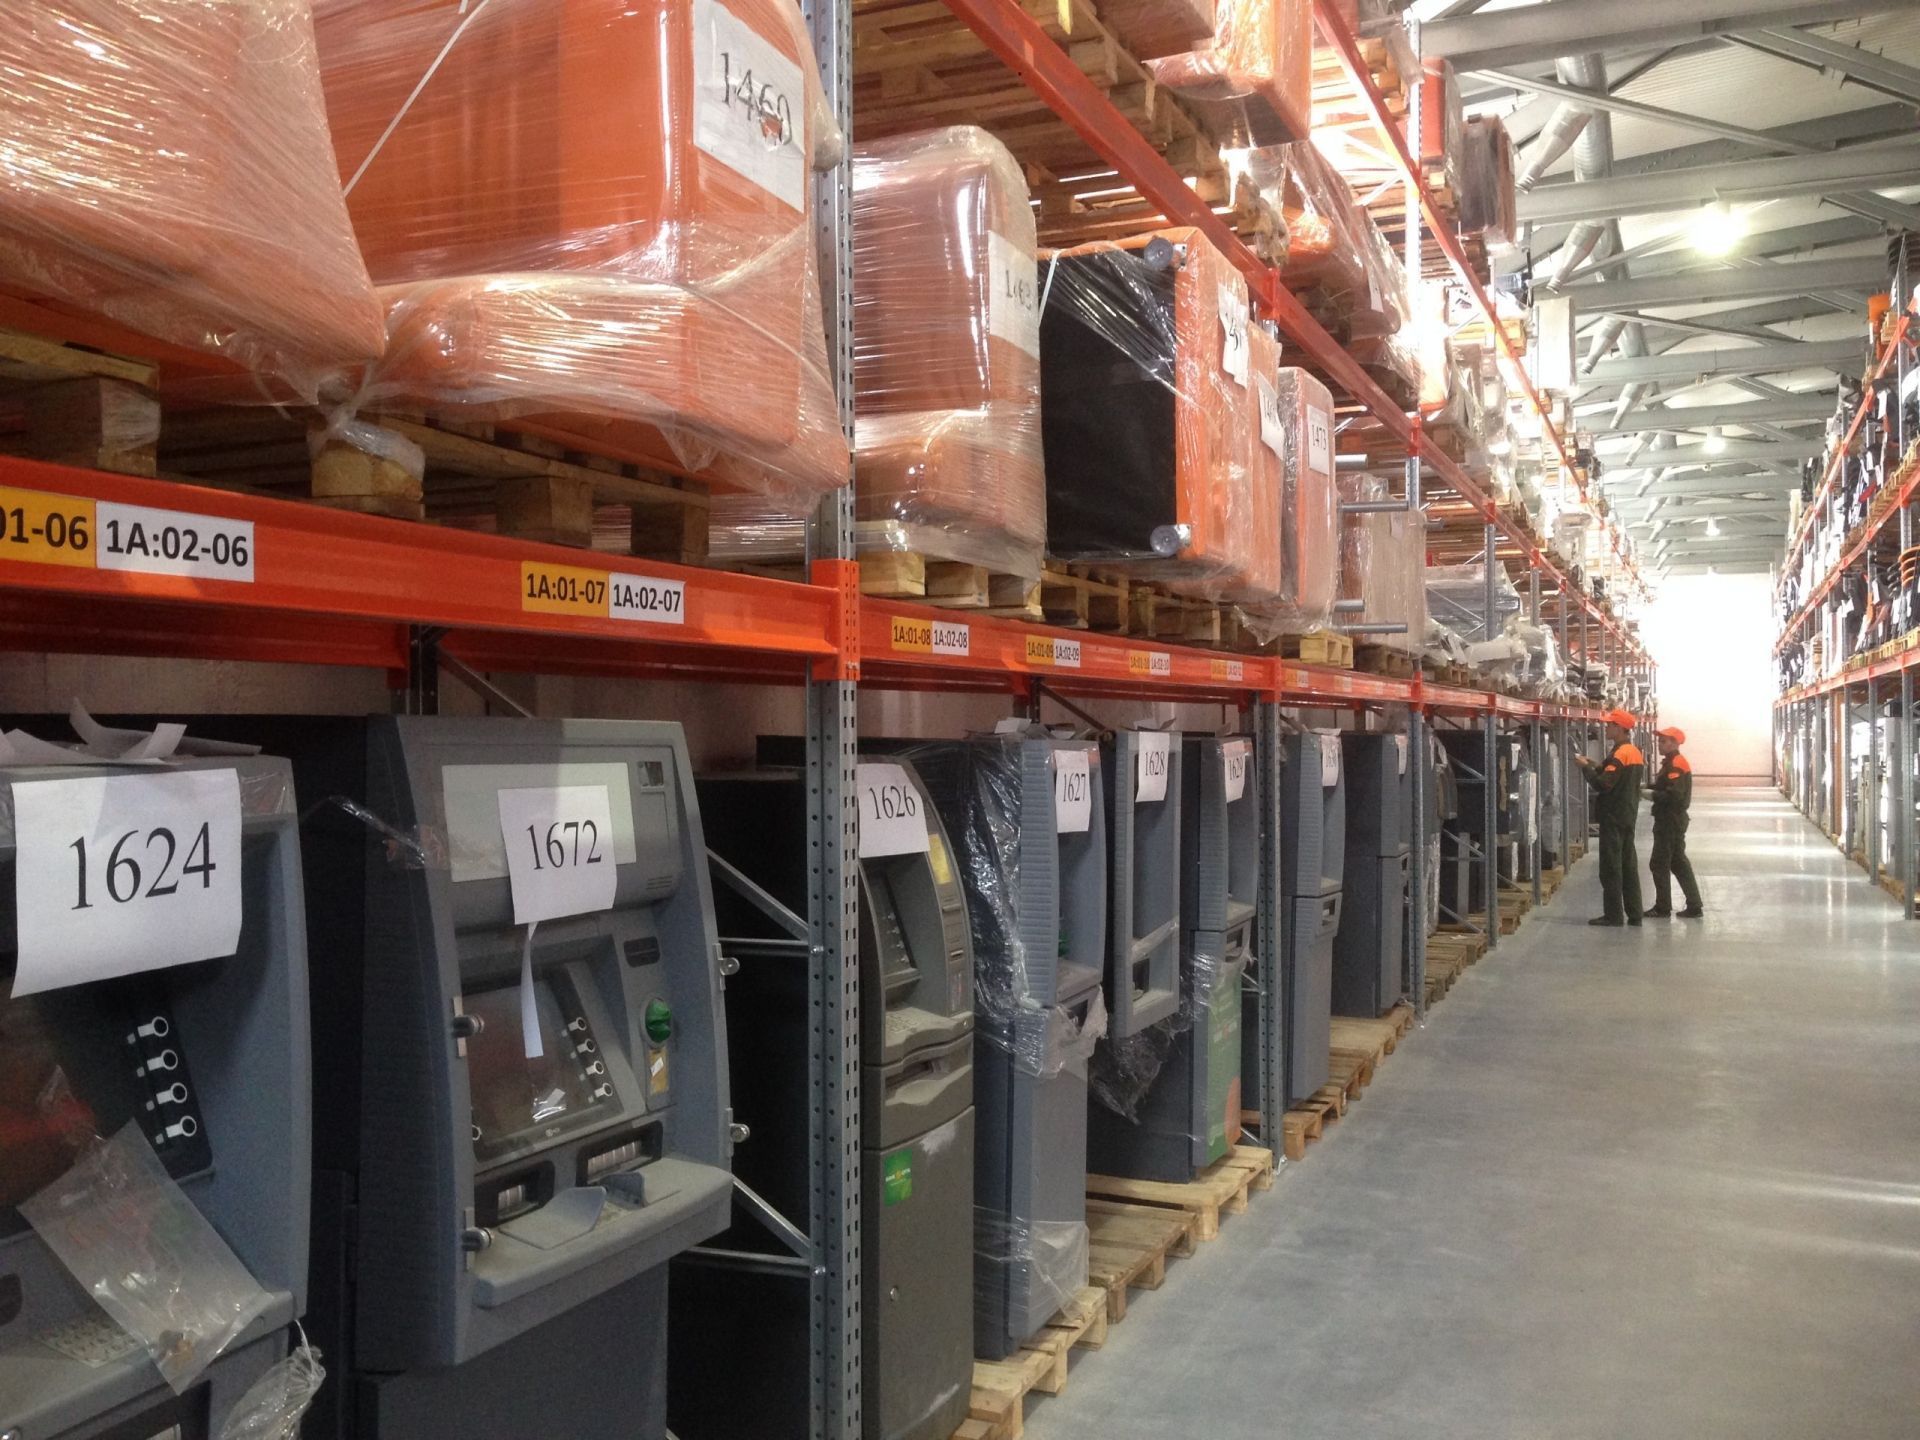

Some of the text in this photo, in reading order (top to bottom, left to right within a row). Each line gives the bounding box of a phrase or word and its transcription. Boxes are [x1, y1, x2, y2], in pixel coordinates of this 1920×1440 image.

[106, 520, 248, 567] 1A:02-06
[526, 573, 605, 604] 1A:01-07
[613, 584, 681, 612] 1A:02-07
[893, 626, 931, 644] 1A:01-08
[934, 629, 968, 648] 1A:02-08
[1028, 642, 1053, 658] 1A:01-09
[1055, 645, 1079, 661] 1A:02-09
[1145, 751, 1165, 776] 1628
[1063, 773, 1086, 802] 1627
[869, 785, 916, 820] 1626
[526, 819, 602, 870] 1672
[69, 821, 216, 910] 1624
